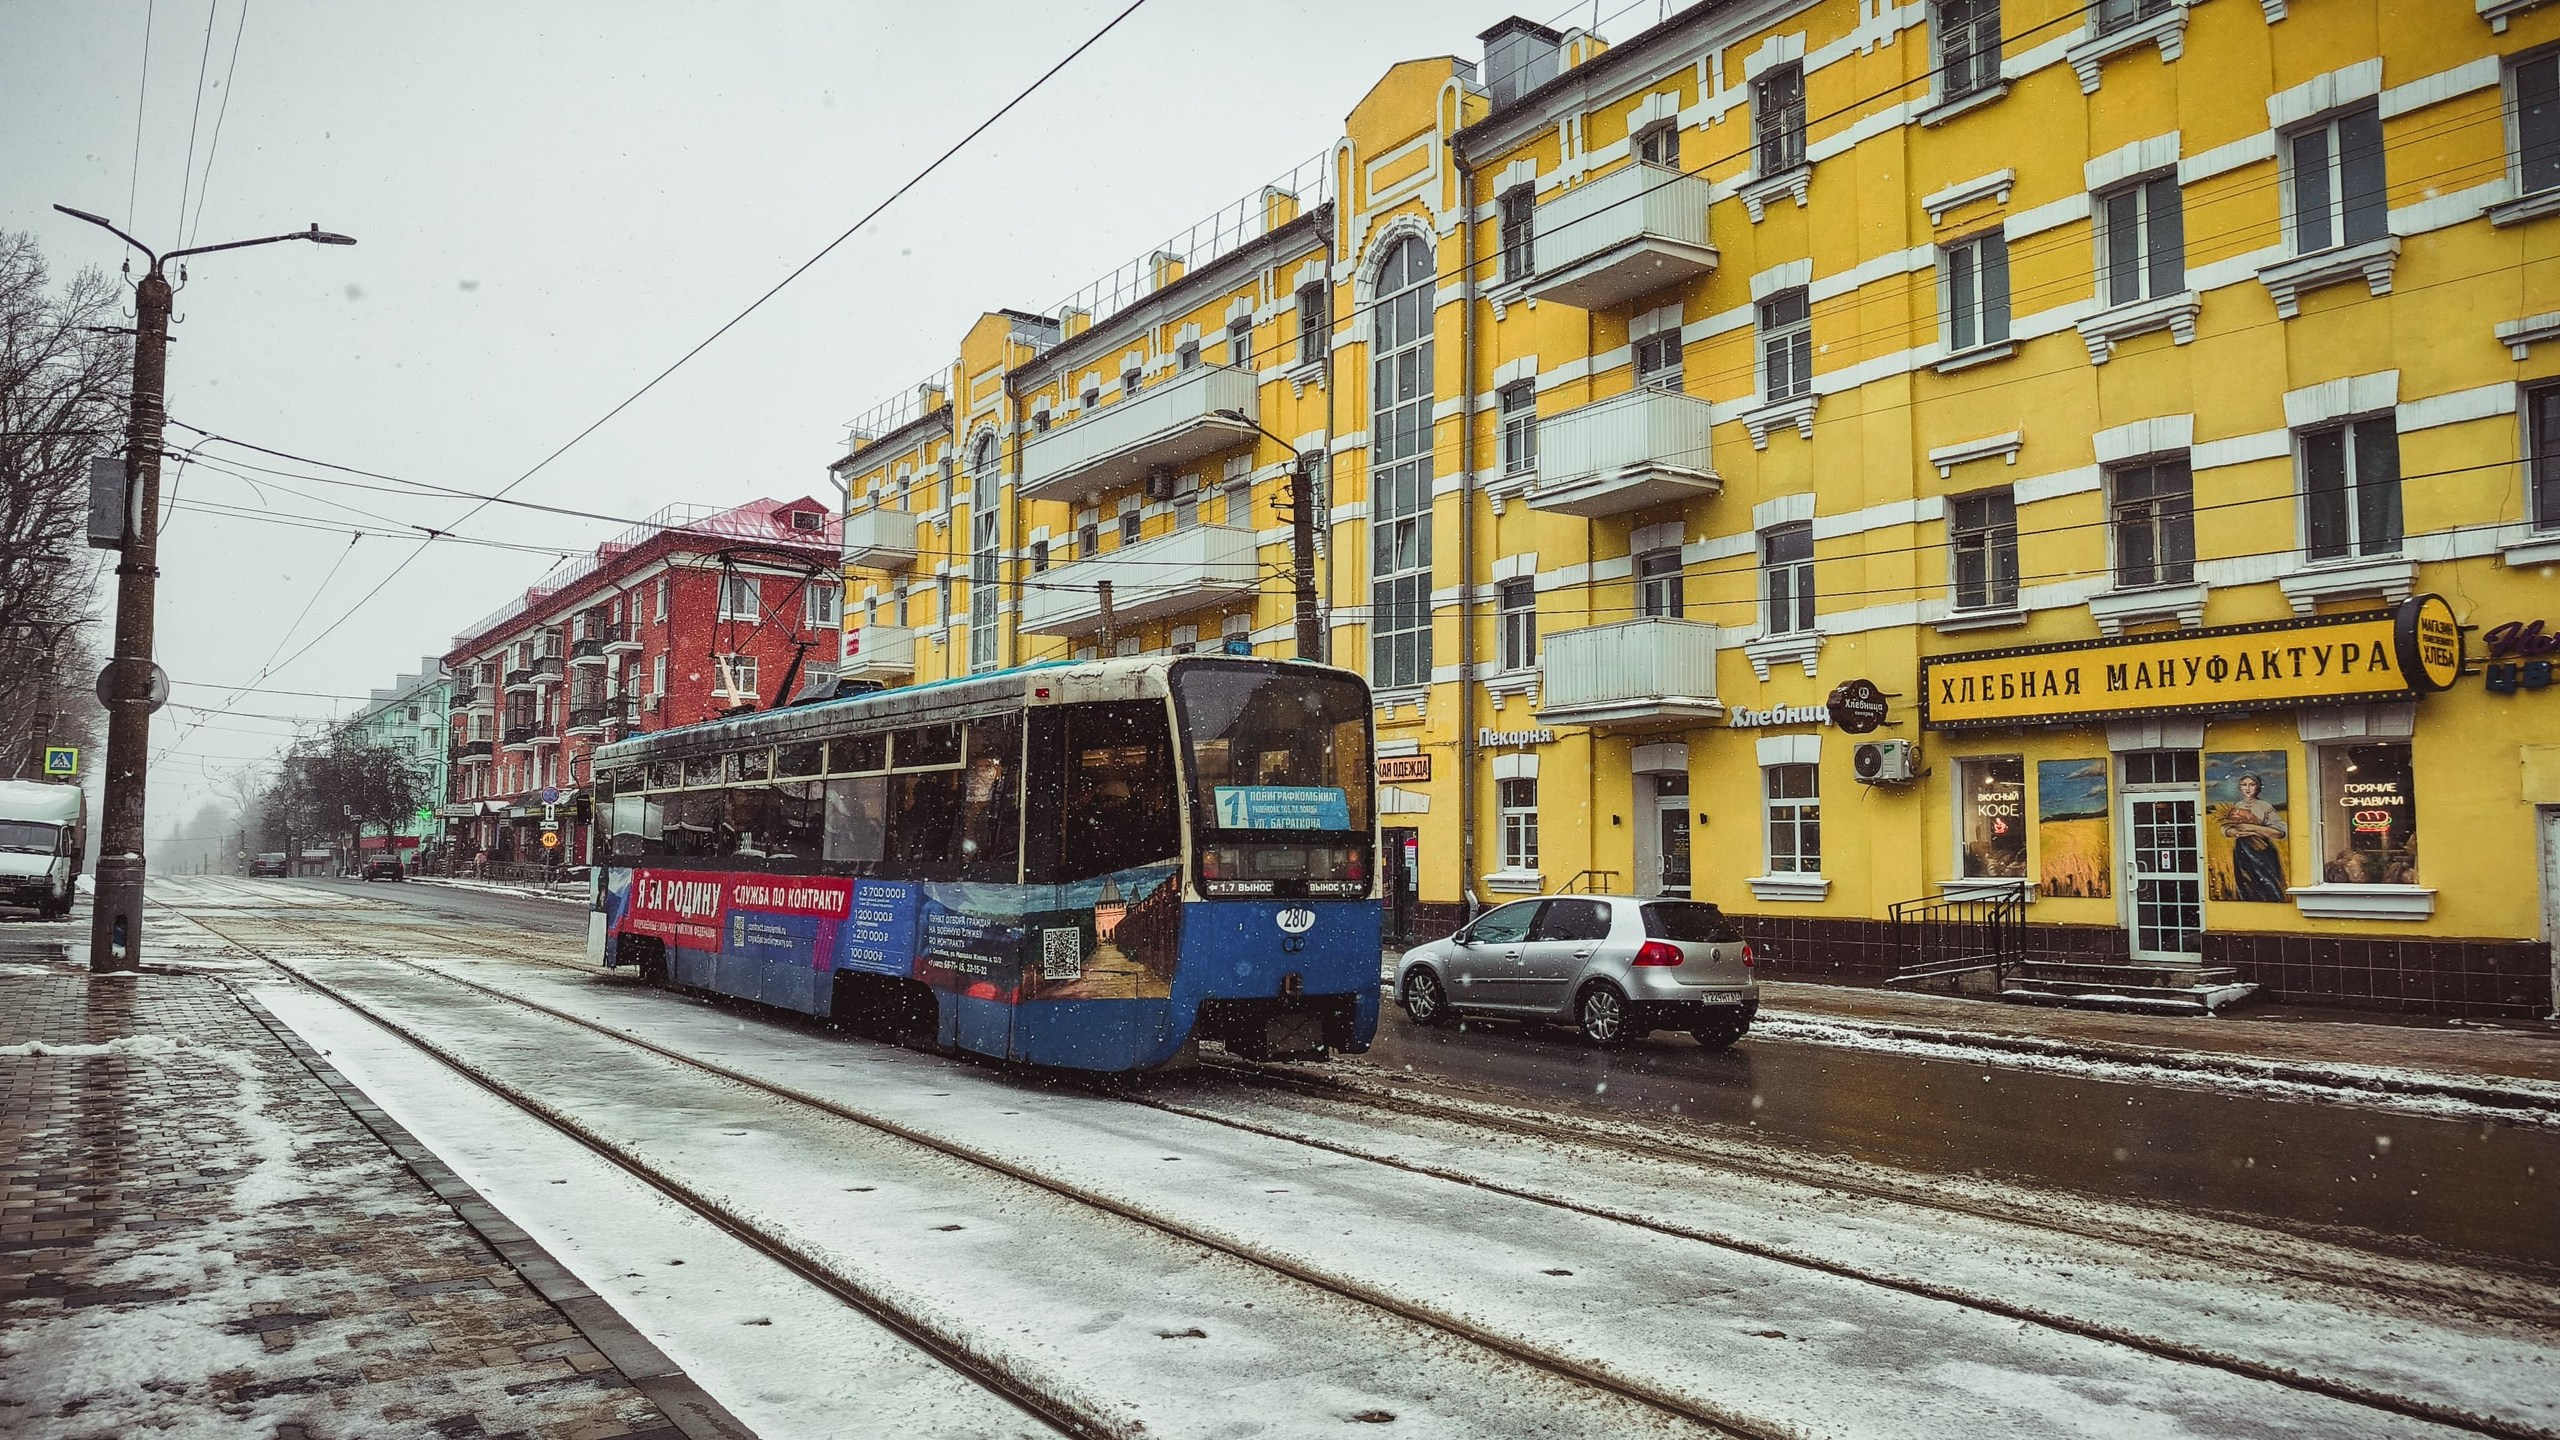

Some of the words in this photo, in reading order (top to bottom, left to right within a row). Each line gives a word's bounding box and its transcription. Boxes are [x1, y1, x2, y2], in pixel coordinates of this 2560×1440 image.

[2423, 644, 2456, 669] ХЛЕБА
[1940, 667, 2081, 704] ХЛЕБНАЯ
[2105, 639, 2391, 693] МАНУФАКТУРА
[1844, 698, 1884, 712] Хлебница
[1478, 726, 1556, 750] Пекарня
[1393, 760, 1428, 778] ОДЕЖДА
[2344, 782, 2398, 793] ГОРЯЧИЕ
[1977, 790, 2020, 802] ВКУСНЫЙ
[2339, 795, 2404, 806] СЭНДВИЧИ
[1224, 791, 1240, 826] 1
[1978, 803, 2020, 817] КОФЕ
[544, 835, 555, 843] 40
[869, 887, 883, 897] 700
[885, 888, 901, 898] 000
[1219, 883, 1235, 892] 1.7
[1238, 883, 1272, 892] ВЫНОС
[1309, 883, 1339, 892] ВЫНОС
[1341, 883, 1353, 892] 1.7
[636, 879, 646, 909] Я
[648, 879, 662, 910] ЗА
[665, 880, 722, 919] РОДИНУ
[734, 885, 769, 906] СЛУЖБА
[771, 887, 785, 907] ПО
[787, 888, 845, 912] КОНТРАКТУ
[1283, 908, 1308, 928] 280
[868, 930, 884, 942] 000
